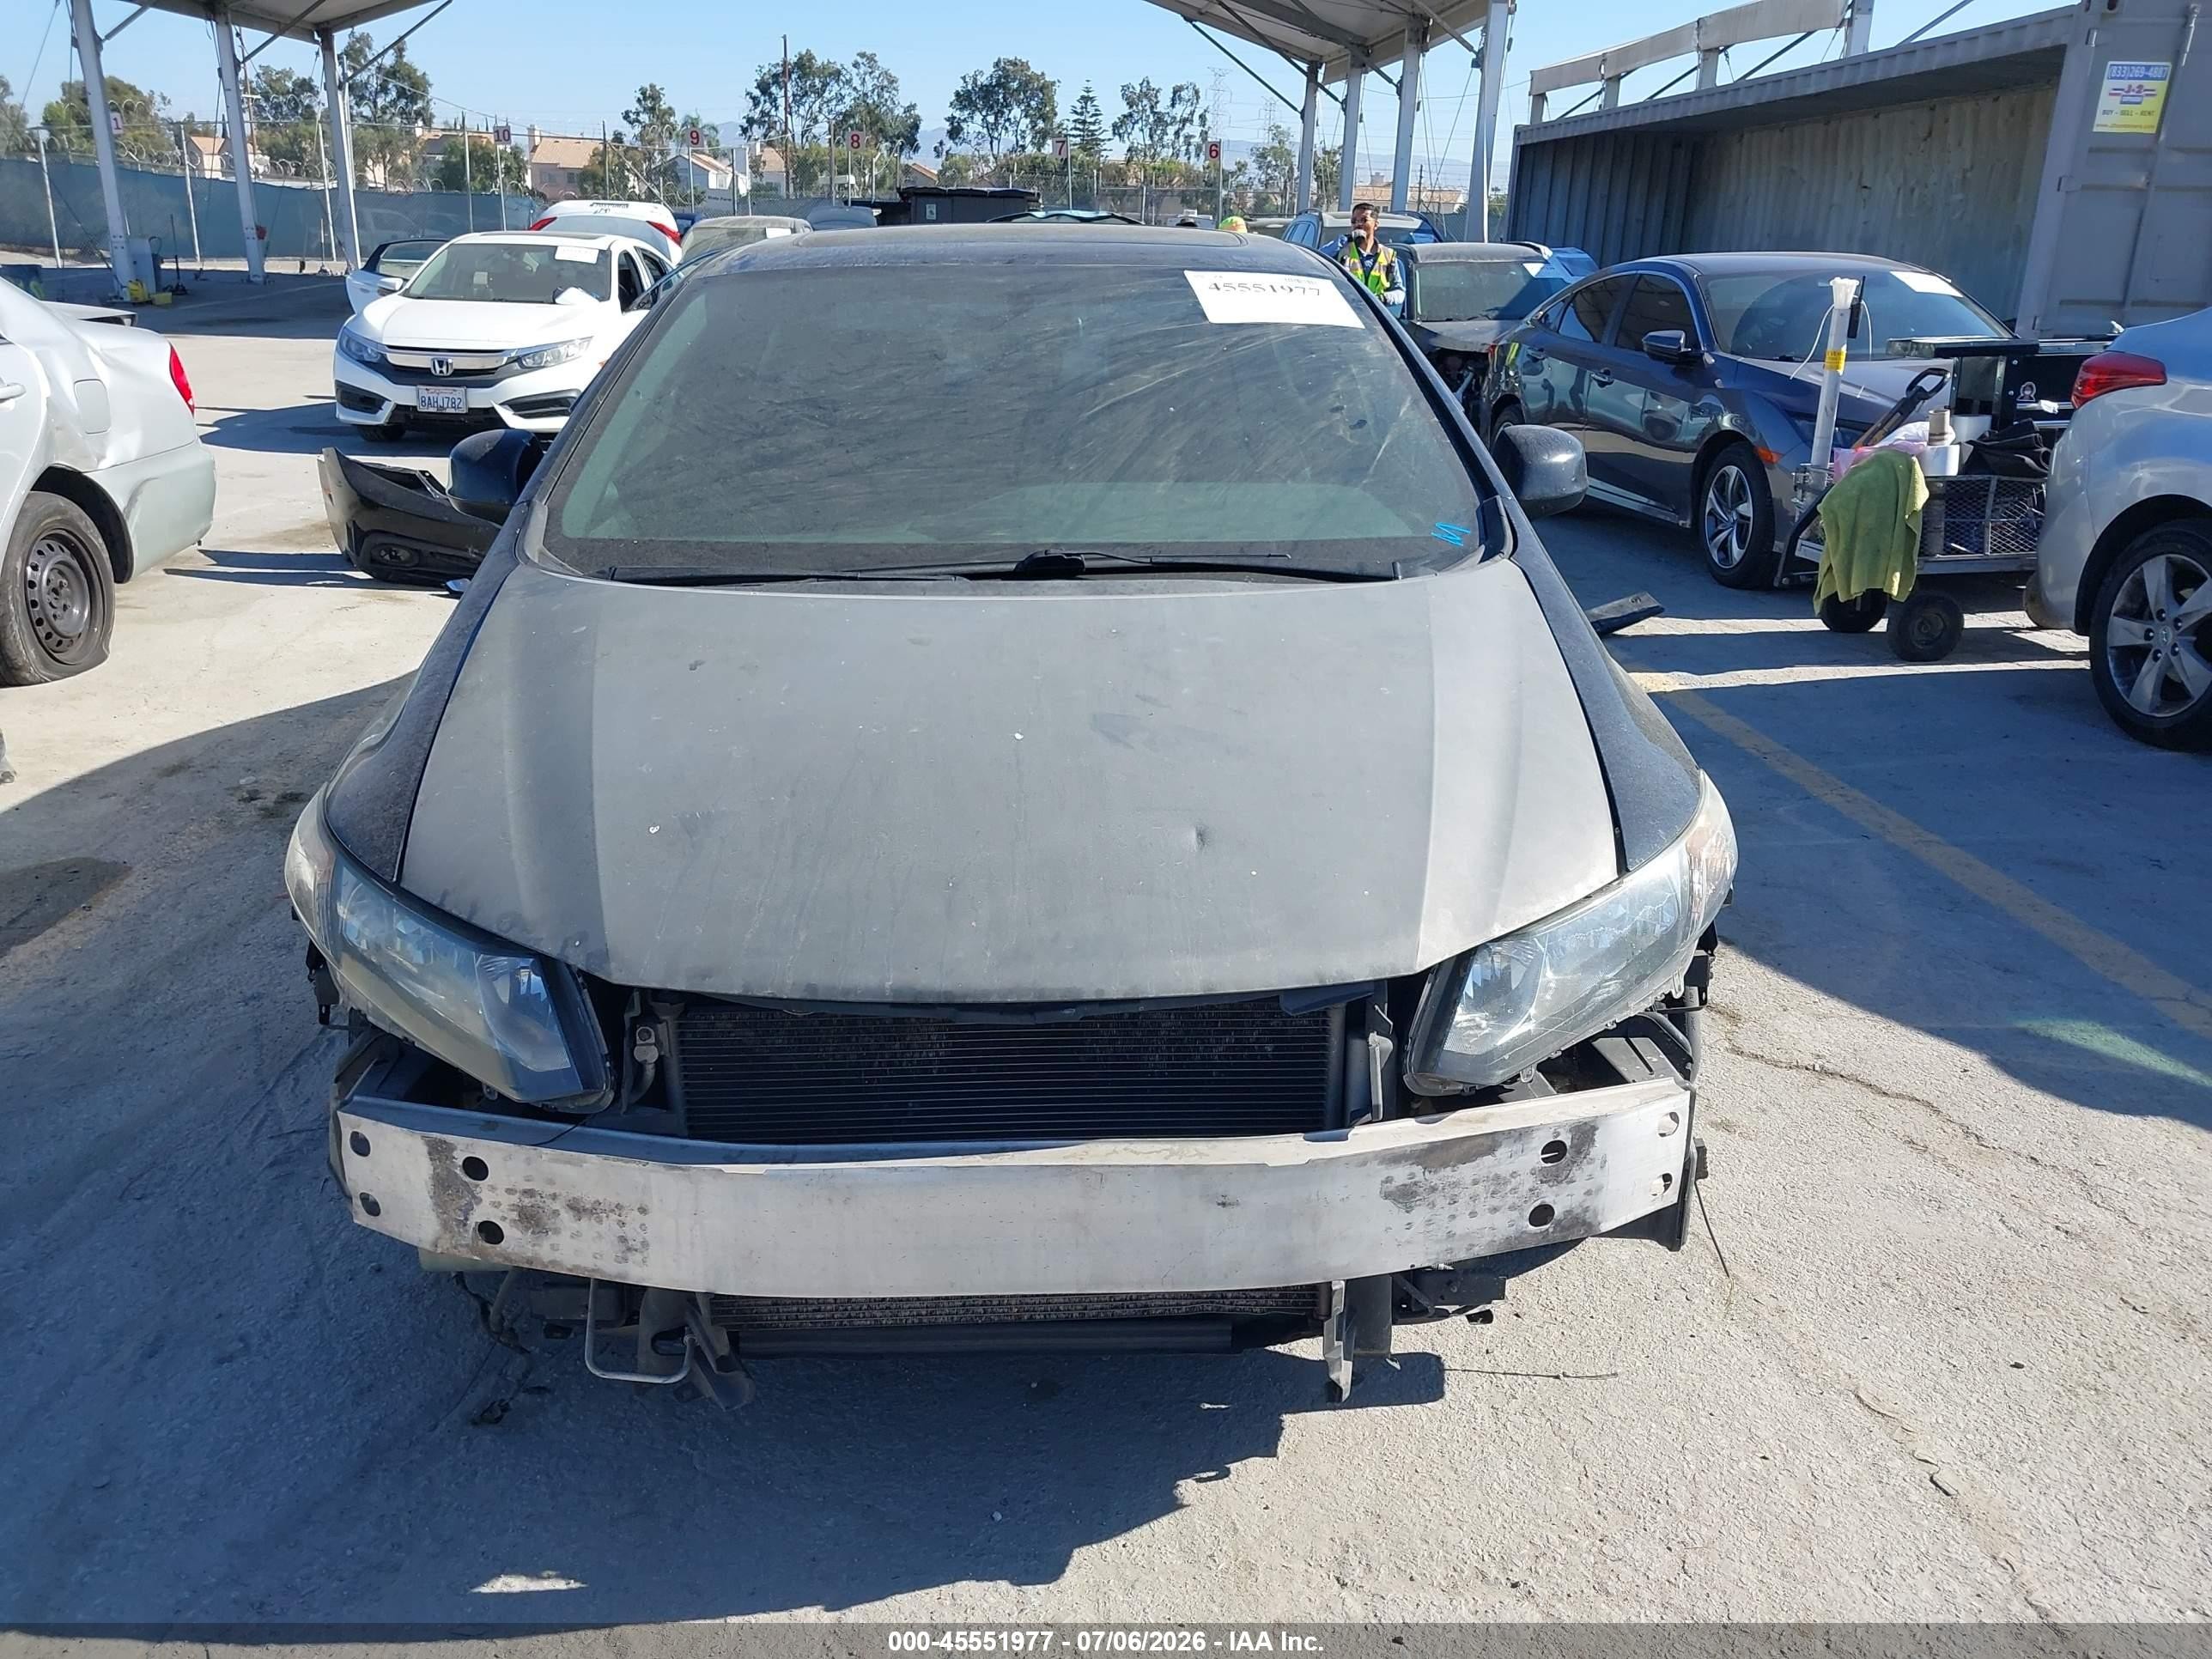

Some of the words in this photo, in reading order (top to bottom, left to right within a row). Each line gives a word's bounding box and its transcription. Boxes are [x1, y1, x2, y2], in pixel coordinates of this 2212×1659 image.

[112, 117, 122, 130] 1
[494, 129, 510, 142] 10
[690, 130, 700, 145] 9
[851, 133, 860, 149] 8
[1055, 140, 1066, 155] 7
[1209, 143, 1218, 159] 6
[1208, 282, 1321, 296] 45551977
[421, 395, 462, 410] 8AHJ782
